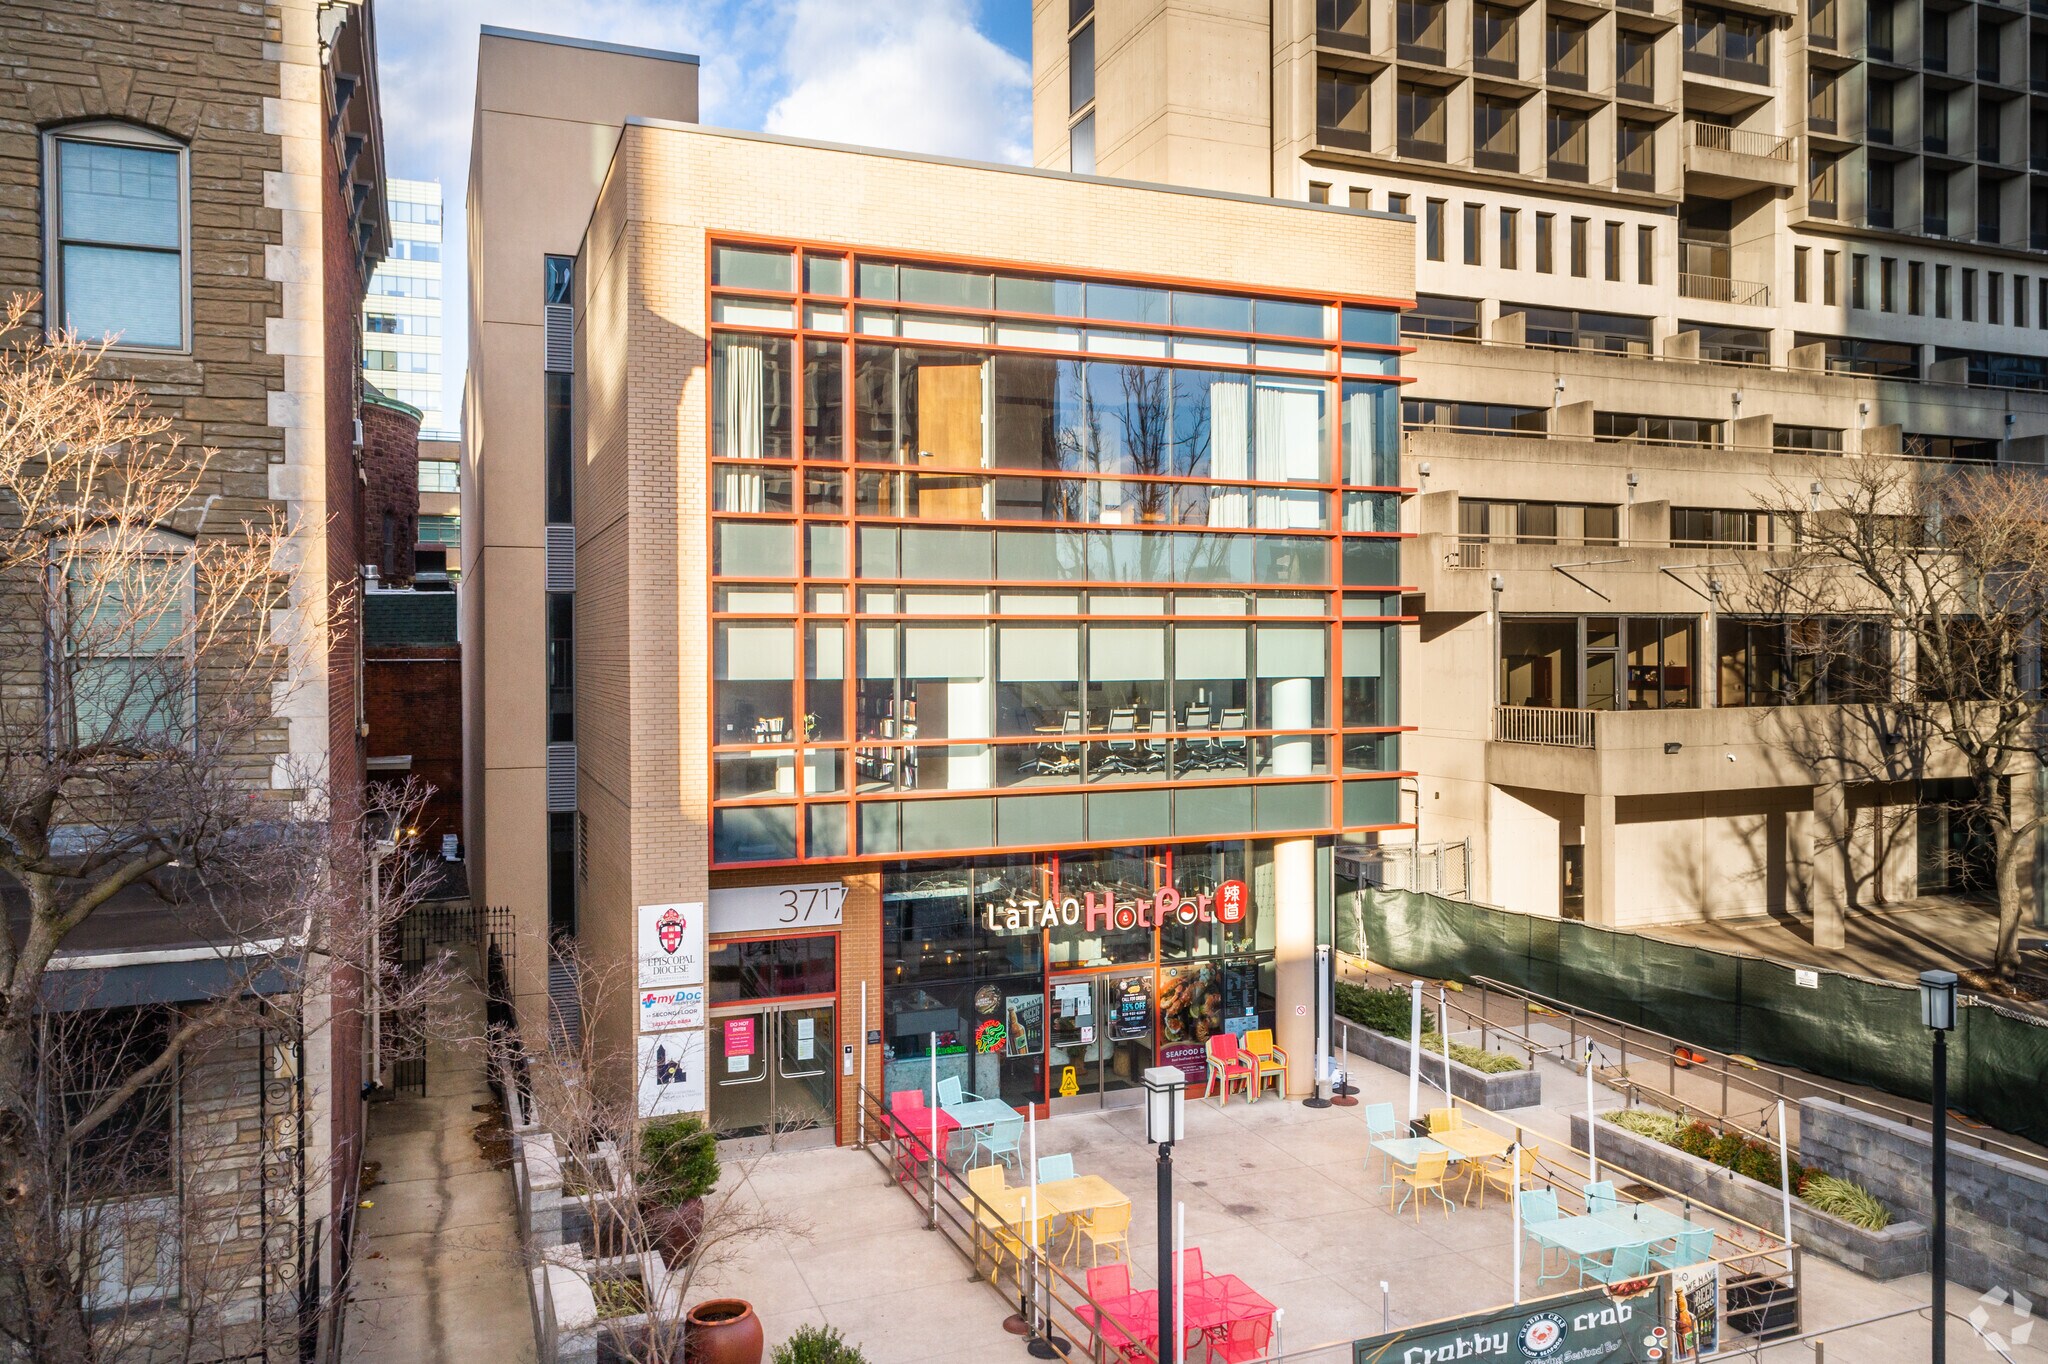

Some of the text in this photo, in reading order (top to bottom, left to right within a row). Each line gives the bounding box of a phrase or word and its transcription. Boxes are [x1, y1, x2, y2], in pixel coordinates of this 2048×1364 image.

[779, 887, 848, 923] 3717
[1223, 884, 1240, 921] 辣道
[647, 955, 695, 967] EPISCOPAL
[653, 964, 689, 975] DIOCESE
[657, 991, 702, 1005] myDoc
[1016, 996, 1042, 1010] WE HAVE
[1122, 1002, 1146, 1011] 15% OFF
[1023, 1005, 1040, 1021] BEER
[925, 1045, 967, 1056] Hineken
[1166, 1048, 1198, 1058] SEAFOOD
[1685, 1268, 1716, 1291] WE HAVE
[1695, 1281, 1714, 1307] BEER
[1403, 1302, 1632, 1364] Crabby crab
[1520, 1313, 1566, 1339] CRABBY CRAB
[1522, 1337, 1563, 1357] CAJUN SEAFOOD
[1563, 1343, 1604, 1362] Seafood
